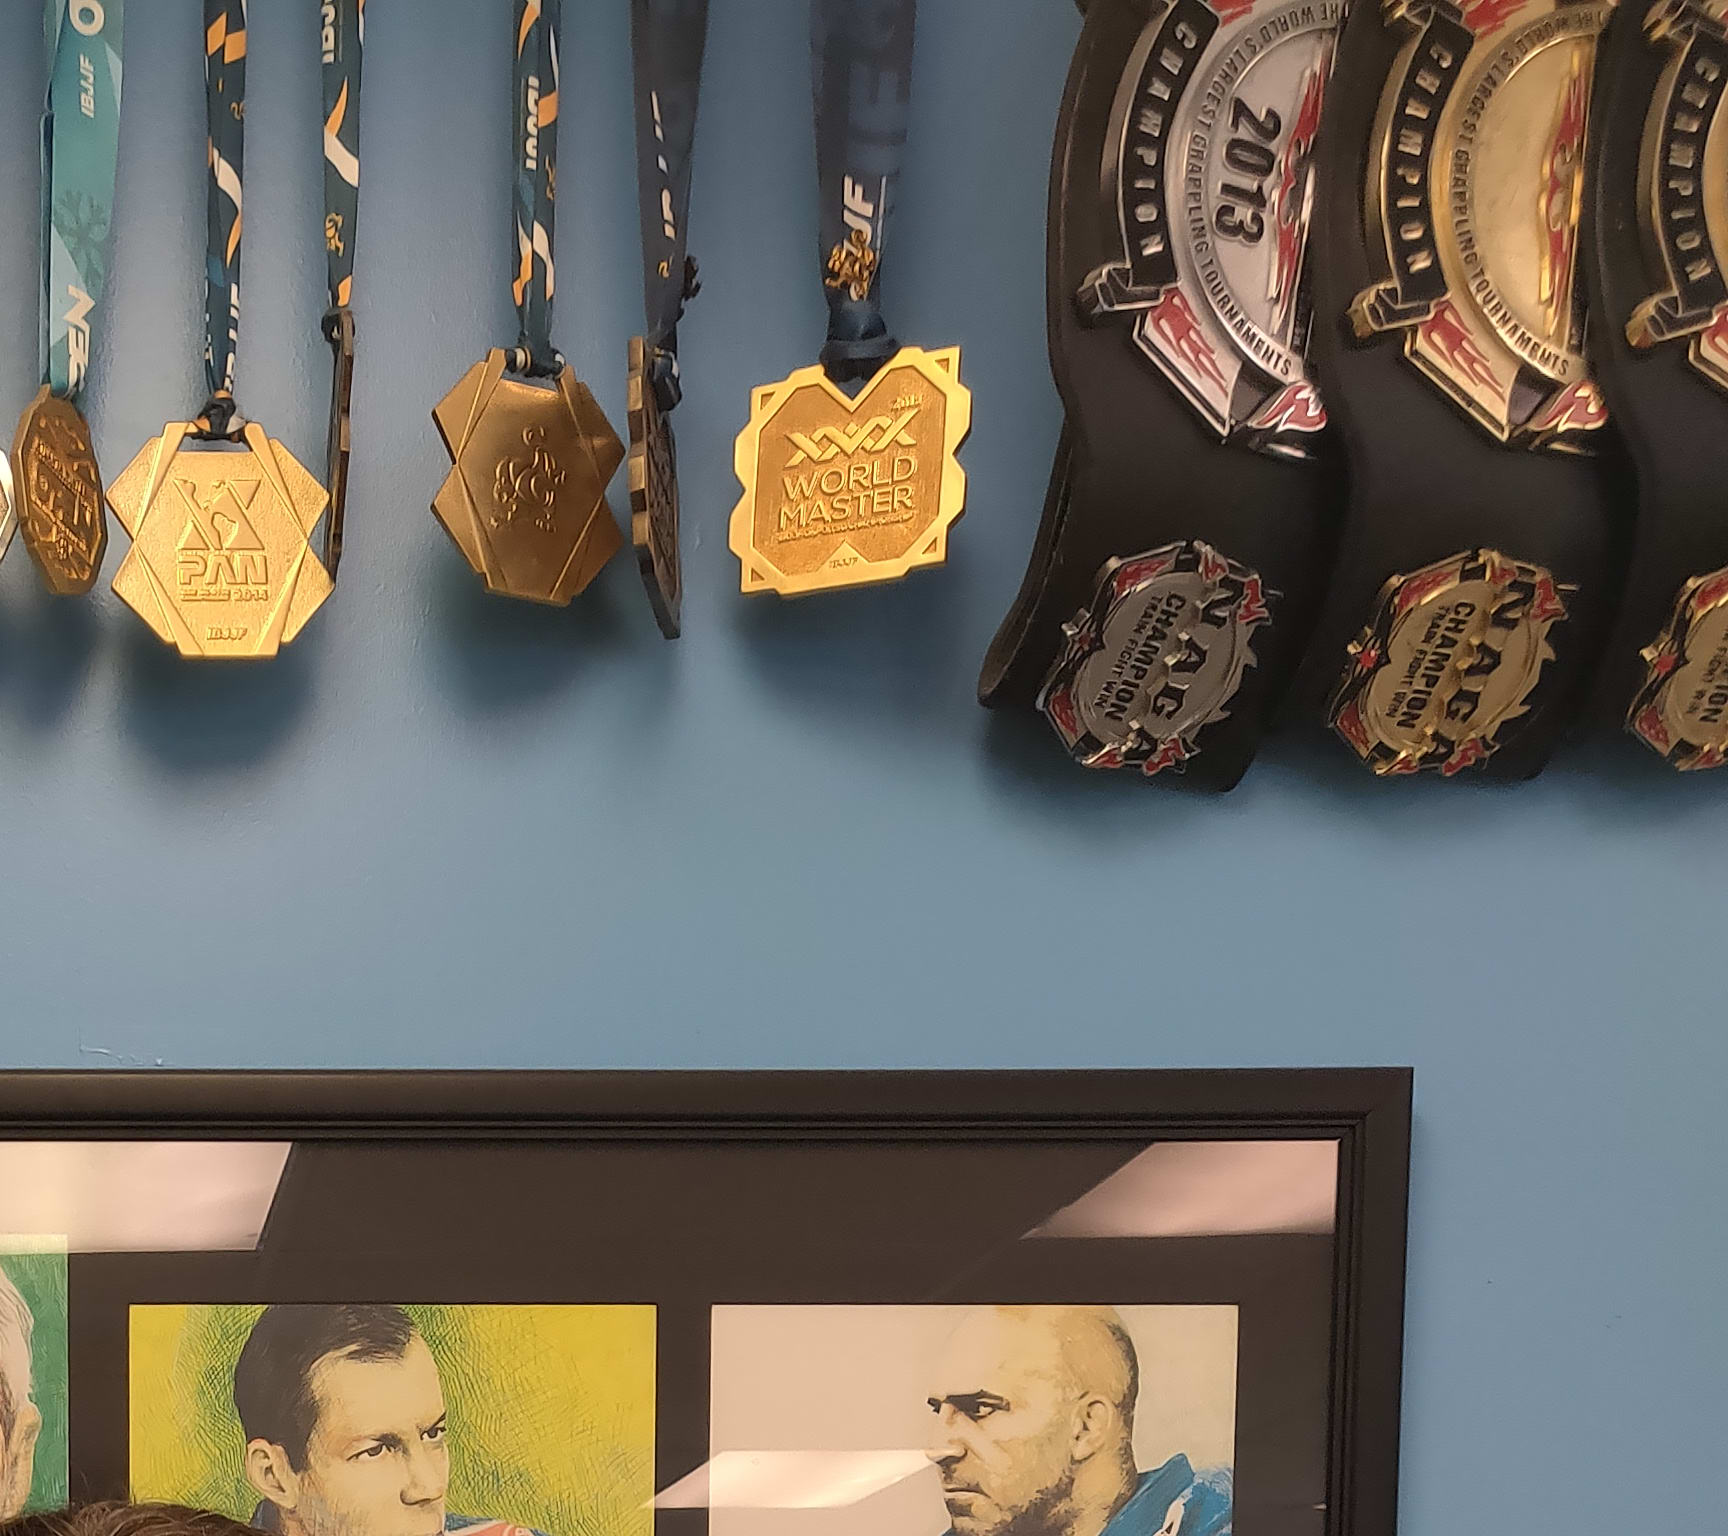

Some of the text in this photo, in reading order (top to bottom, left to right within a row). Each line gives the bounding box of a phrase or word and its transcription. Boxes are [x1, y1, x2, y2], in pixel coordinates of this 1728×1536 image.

[79, 54, 96, 119] IBJJF
[1133, 20, 1200, 257] CHAMPION
[1200, 48, 1250, 128] LARGEST
[1185, 131, 1210, 253] GRAPPLING
[1213, 95, 1282, 245] 2013
[1396, 43, 1454, 275] CHAMPION
[1200, 257, 1292, 377] TOURNAMENTS
[1451, 149, 1480, 270] GRAPPLING
[1470, 267, 1571, 377] TOURNAMENTS
[777, 485, 915, 533] MASTER
[782, 456, 918, 501] WORLD
[177, 554, 269, 586] PAN
[1104, 592, 1186, 722] CHAMPION
[1396, 601, 1476, 730] CHAMPION
